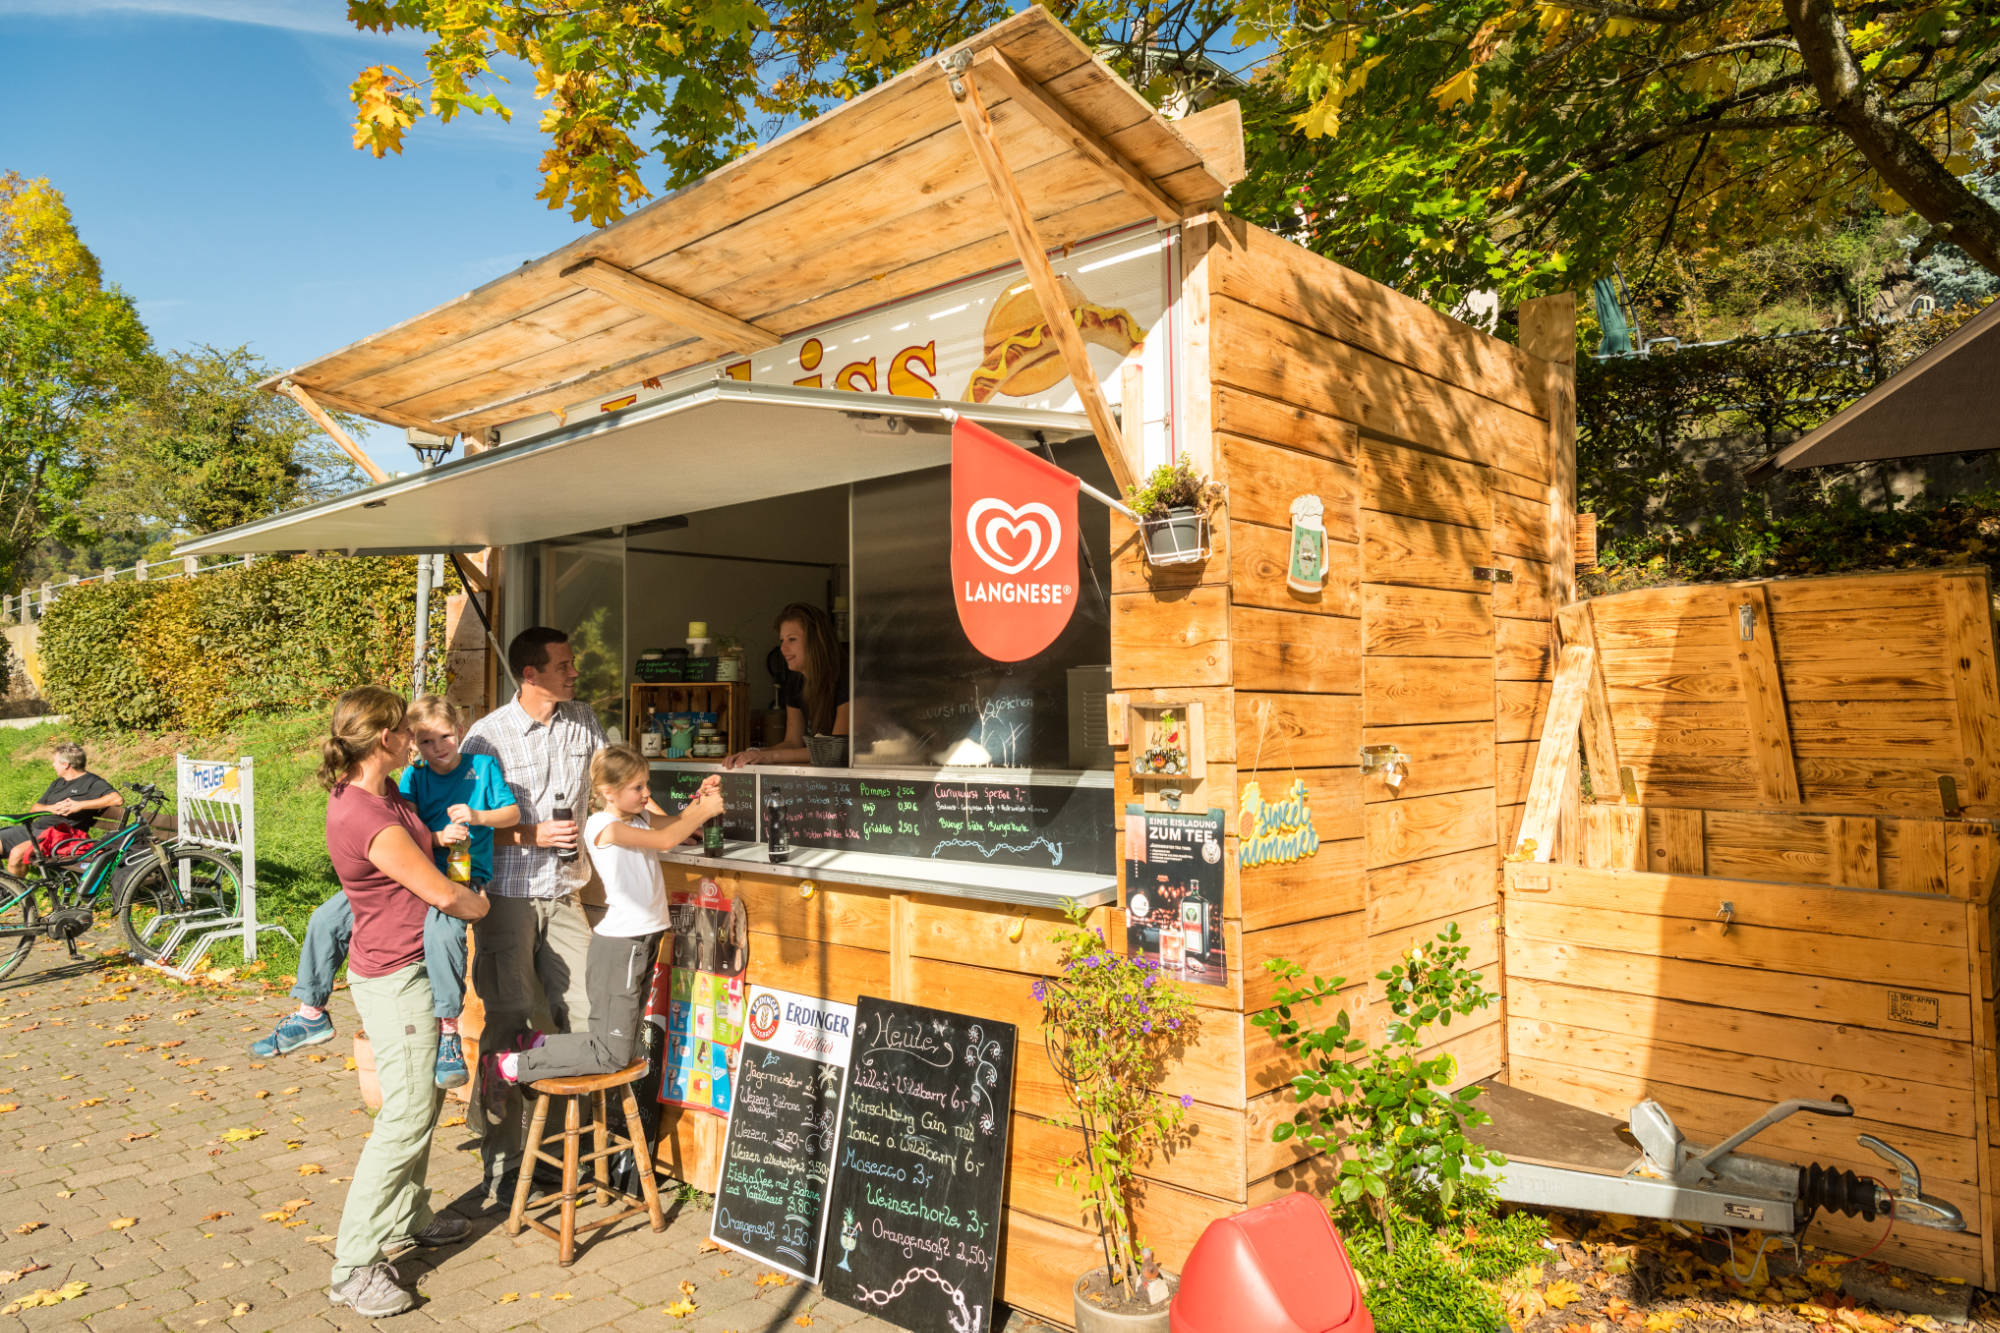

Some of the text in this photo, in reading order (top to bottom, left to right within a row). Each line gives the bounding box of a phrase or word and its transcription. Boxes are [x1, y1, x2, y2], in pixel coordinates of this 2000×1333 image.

[860, 782, 891, 797] Pommes
[1258, 781, 1311, 836] sweet
[1149, 817, 1218, 830] EINE EISLADUNG
[1149, 827, 1181, 841] ZUM
[785, 1002, 850, 1037] ERDINGER
[870, 1012, 940, 1054] Heute
[794, 1029, 834, 1055] Weißbier
[745, 1060, 803, 1089] Jägermeister
[847, 1118, 880, 1147] Tonic
[921, 1111, 947, 1135] Gin
[731, 1141, 761, 1163] Weizen
[842, 1145, 907, 1182] Mosecco
[866, 1181, 961, 1229] Weinschorle
[719, 1207, 776, 1244] Orangensaft
[872, 1217, 951, 1262] Orangensaft
